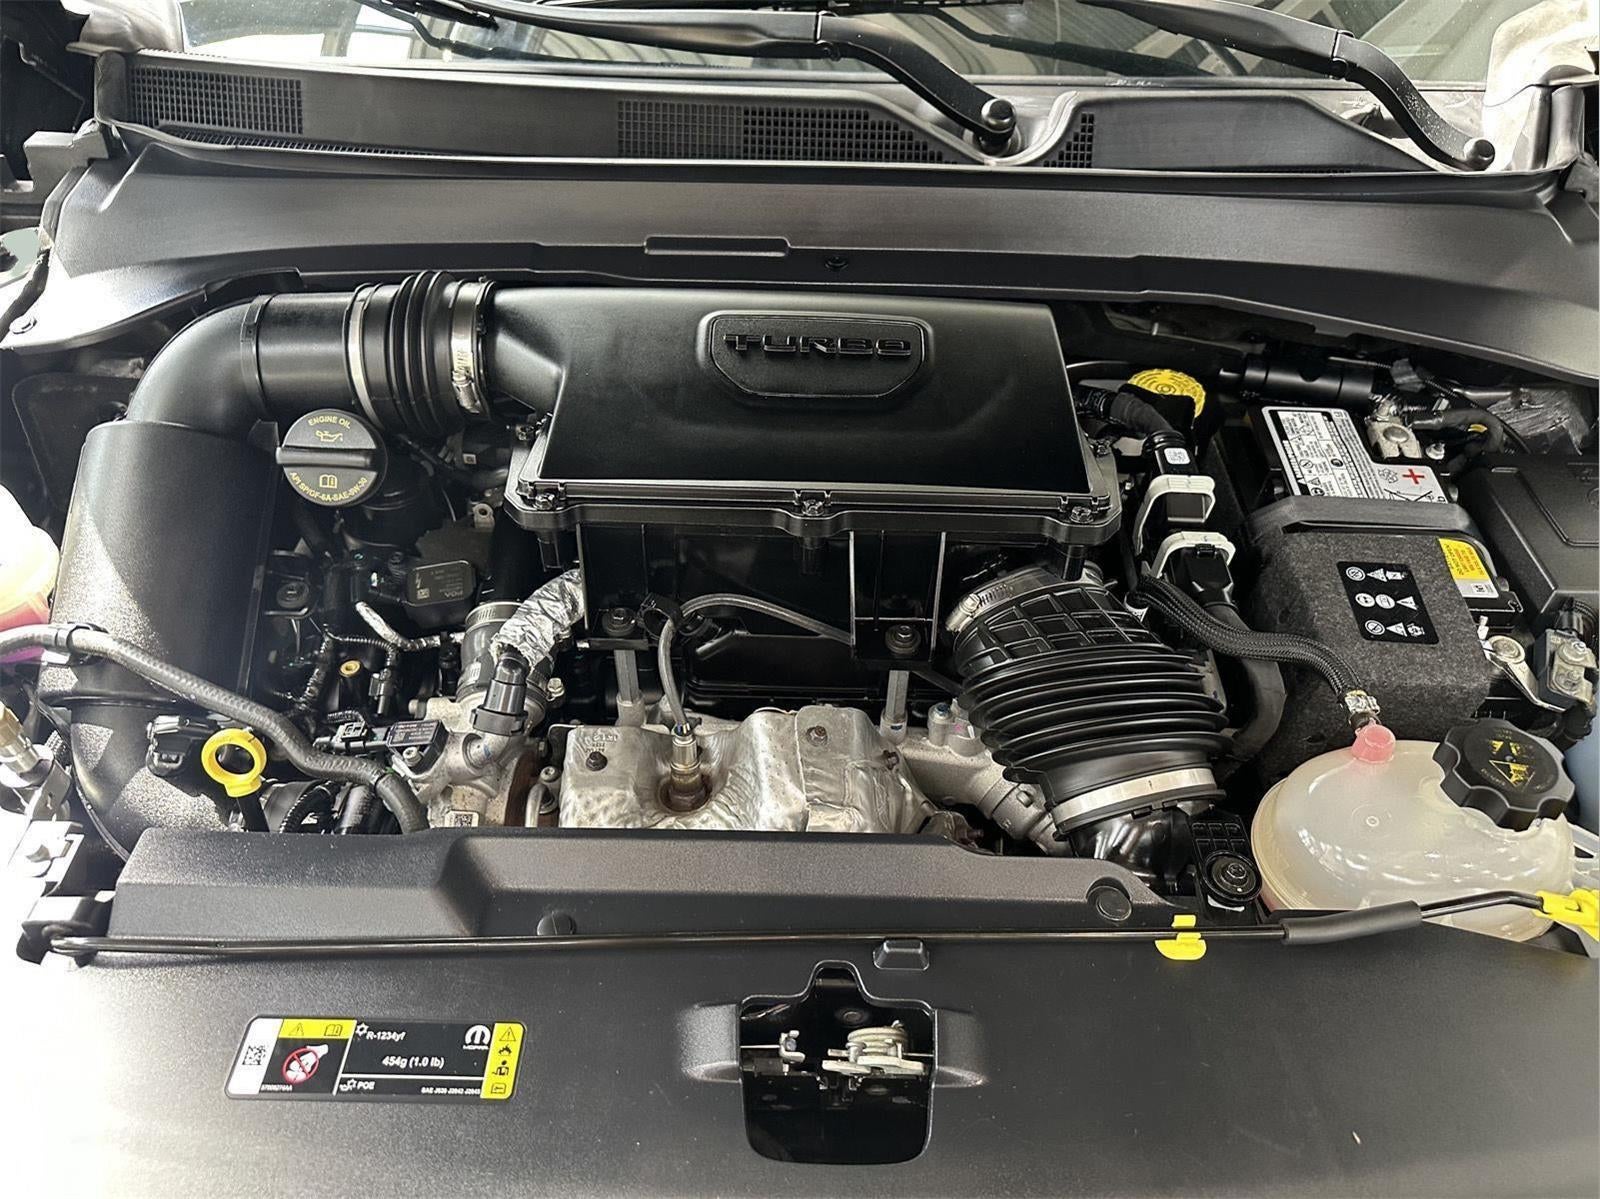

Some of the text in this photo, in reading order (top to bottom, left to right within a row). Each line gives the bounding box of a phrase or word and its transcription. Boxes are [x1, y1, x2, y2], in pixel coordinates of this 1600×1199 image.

[723, 334, 912, 356] TURBO
[308, 416, 351, 429] ENGINE OIL
[290, 472, 301, 485] API
[366, 1031, 406, 1042] R-1234yf
[382, 1056, 445, 1069] 454g (1.0 lb)
[357, 1081, 375, 1090] POE
